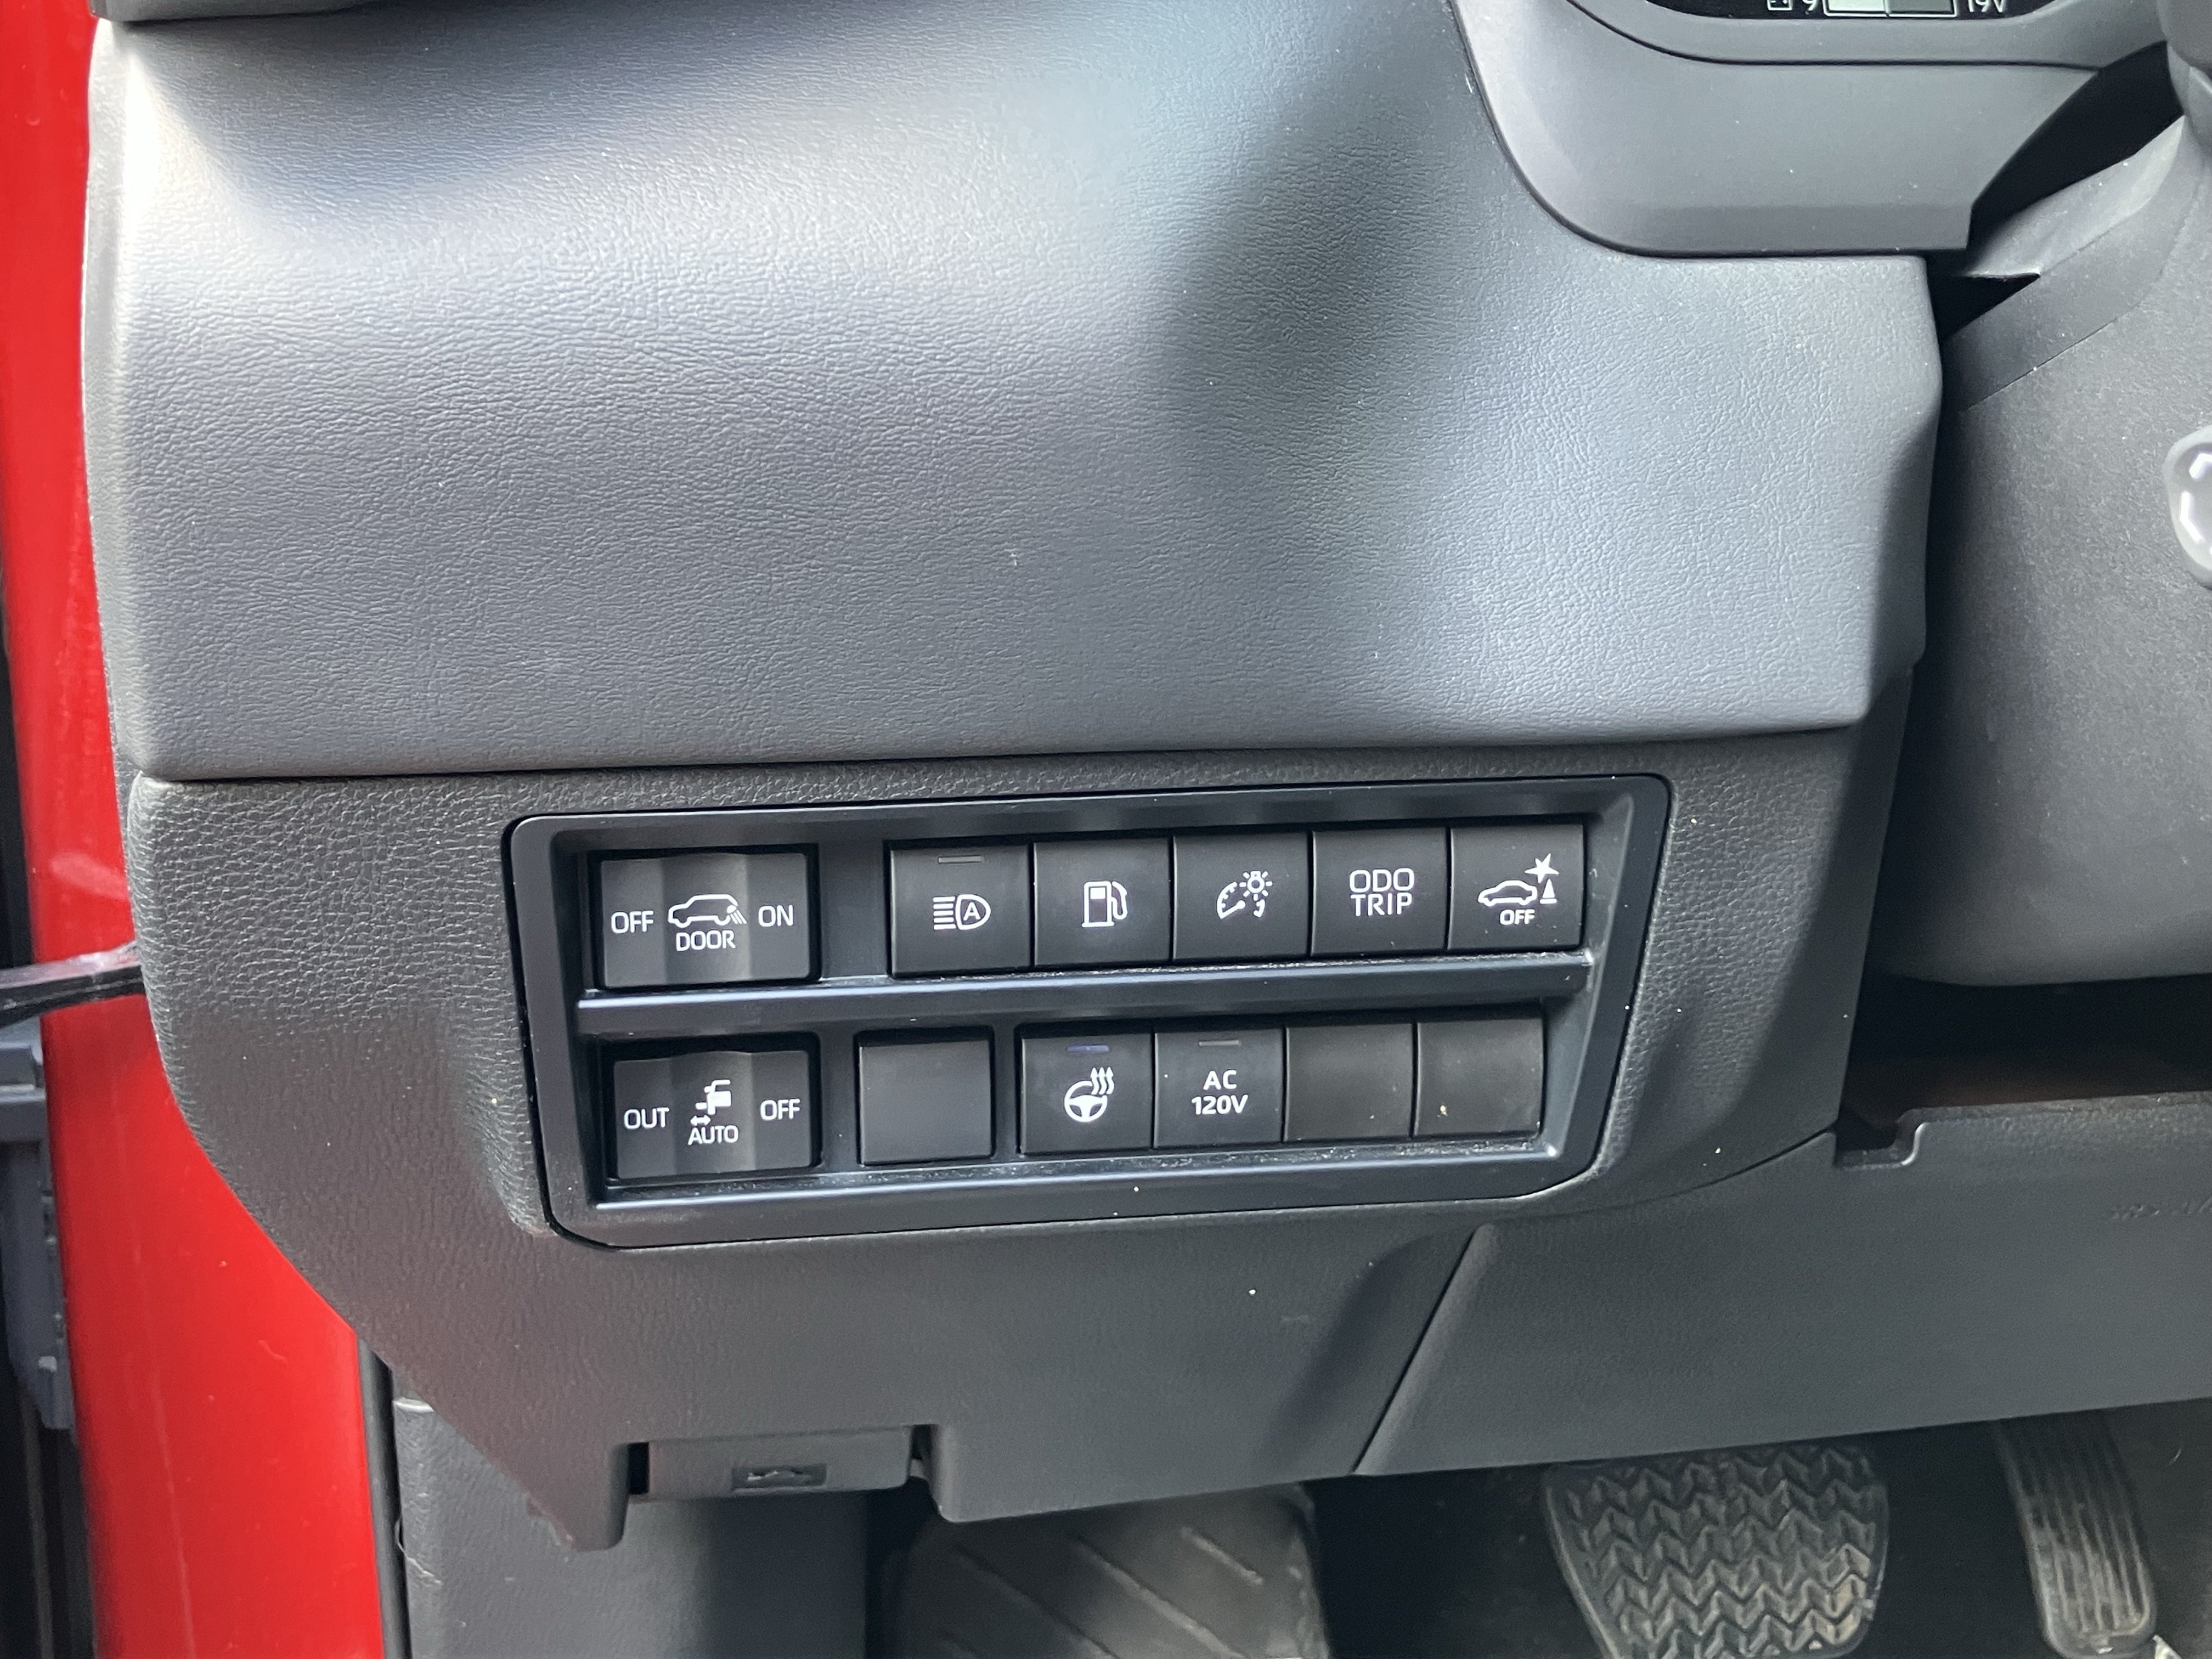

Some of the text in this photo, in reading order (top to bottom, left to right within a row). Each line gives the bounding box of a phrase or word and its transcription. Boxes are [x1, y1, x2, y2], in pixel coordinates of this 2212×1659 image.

[1349, 868, 1415, 893] ODO
[758, 904, 794, 927] ON
[963, 901, 981, 921] A
[1350, 892, 1413, 917] TRIP
[611, 910, 654, 934] OFF
[1499, 909, 1536, 926] OFF
[675, 929, 736, 952] DOOR
[1203, 1069, 1238, 1091] AC
[759, 1098, 801, 1121] OFF
[1190, 1094, 1249, 1116] 120V
[623, 1107, 670, 1130] OUT
[687, 1125, 740, 1146] AUTO
